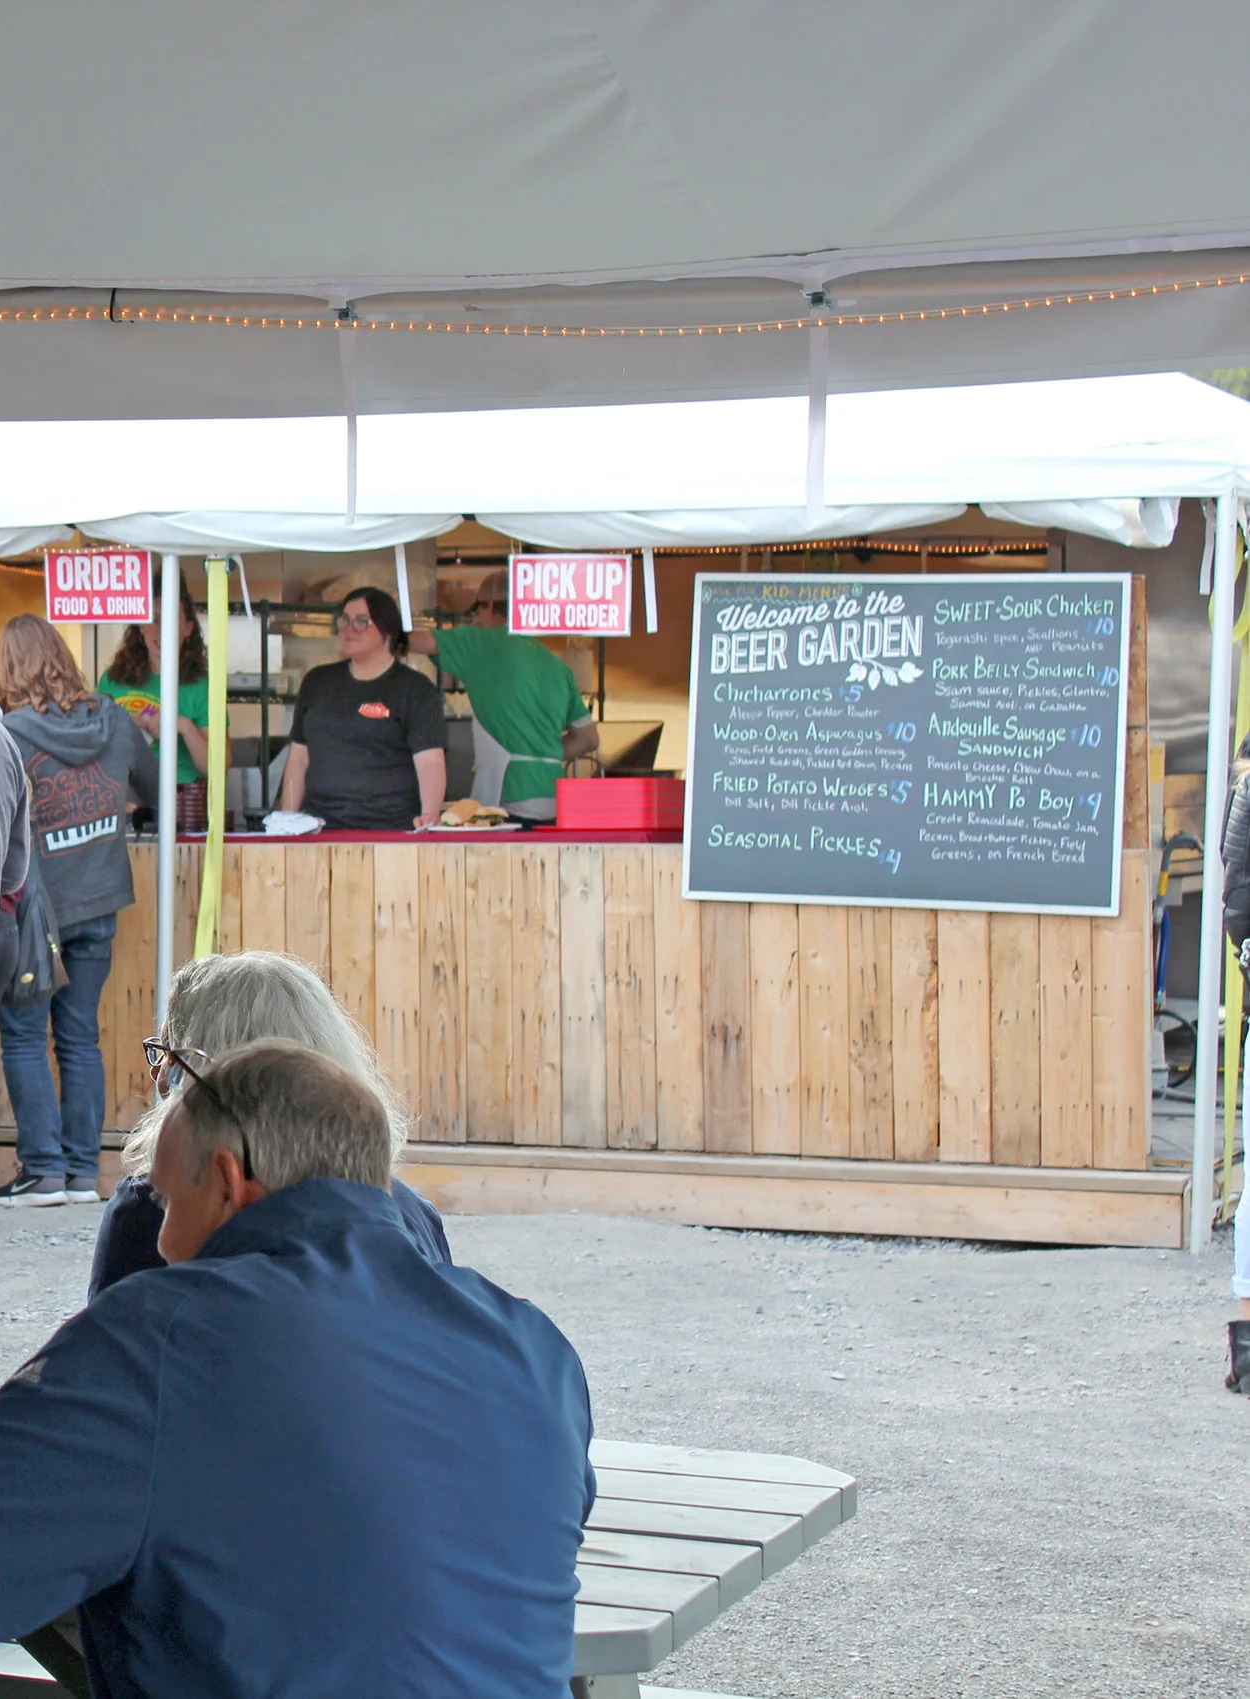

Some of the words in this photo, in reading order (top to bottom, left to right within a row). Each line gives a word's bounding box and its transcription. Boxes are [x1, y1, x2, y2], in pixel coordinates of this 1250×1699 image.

[56, 555, 142, 592] ORDER
[516, 562, 577, 600] PICK
[586, 562, 623, 600] UP
[54, 596, 89, 616] FOOD
[91, 596, 104, 616] &
[106, 596, 146, 616] DRINK
[518, 604, 561, 628] YOUR
[565, 604, 619, 628] ORDER
[717, 600, 830, 632] Welcome
[834, 595, 860, 620] to
[864, 590, 905, 615] the
[710, 629, 788, 674] BEER
[798, 615, 923, 667] GARDEN
[932, 657, 969, 680] PORK
[973, 654, 1020, 680] BELLY
[713, 682, 833, 703] Chicharrones
[805, 720, 883, 747] Asparagus
[928, 711, 1000, 738] Andouille
[1003, 715, 1067, 752] Sausage
[712, 771, 759, 793] FRIED
[766, 772, 818, 796] POTATO
[822, 776, 889, 798] WEDGES
[923, 782, 997, 810] HAMMY
[1038, 787, 1075, 821] Boy
[707, 823, 803, 851] SEASONAL
[810, 826, 882, 858] PICKLES
